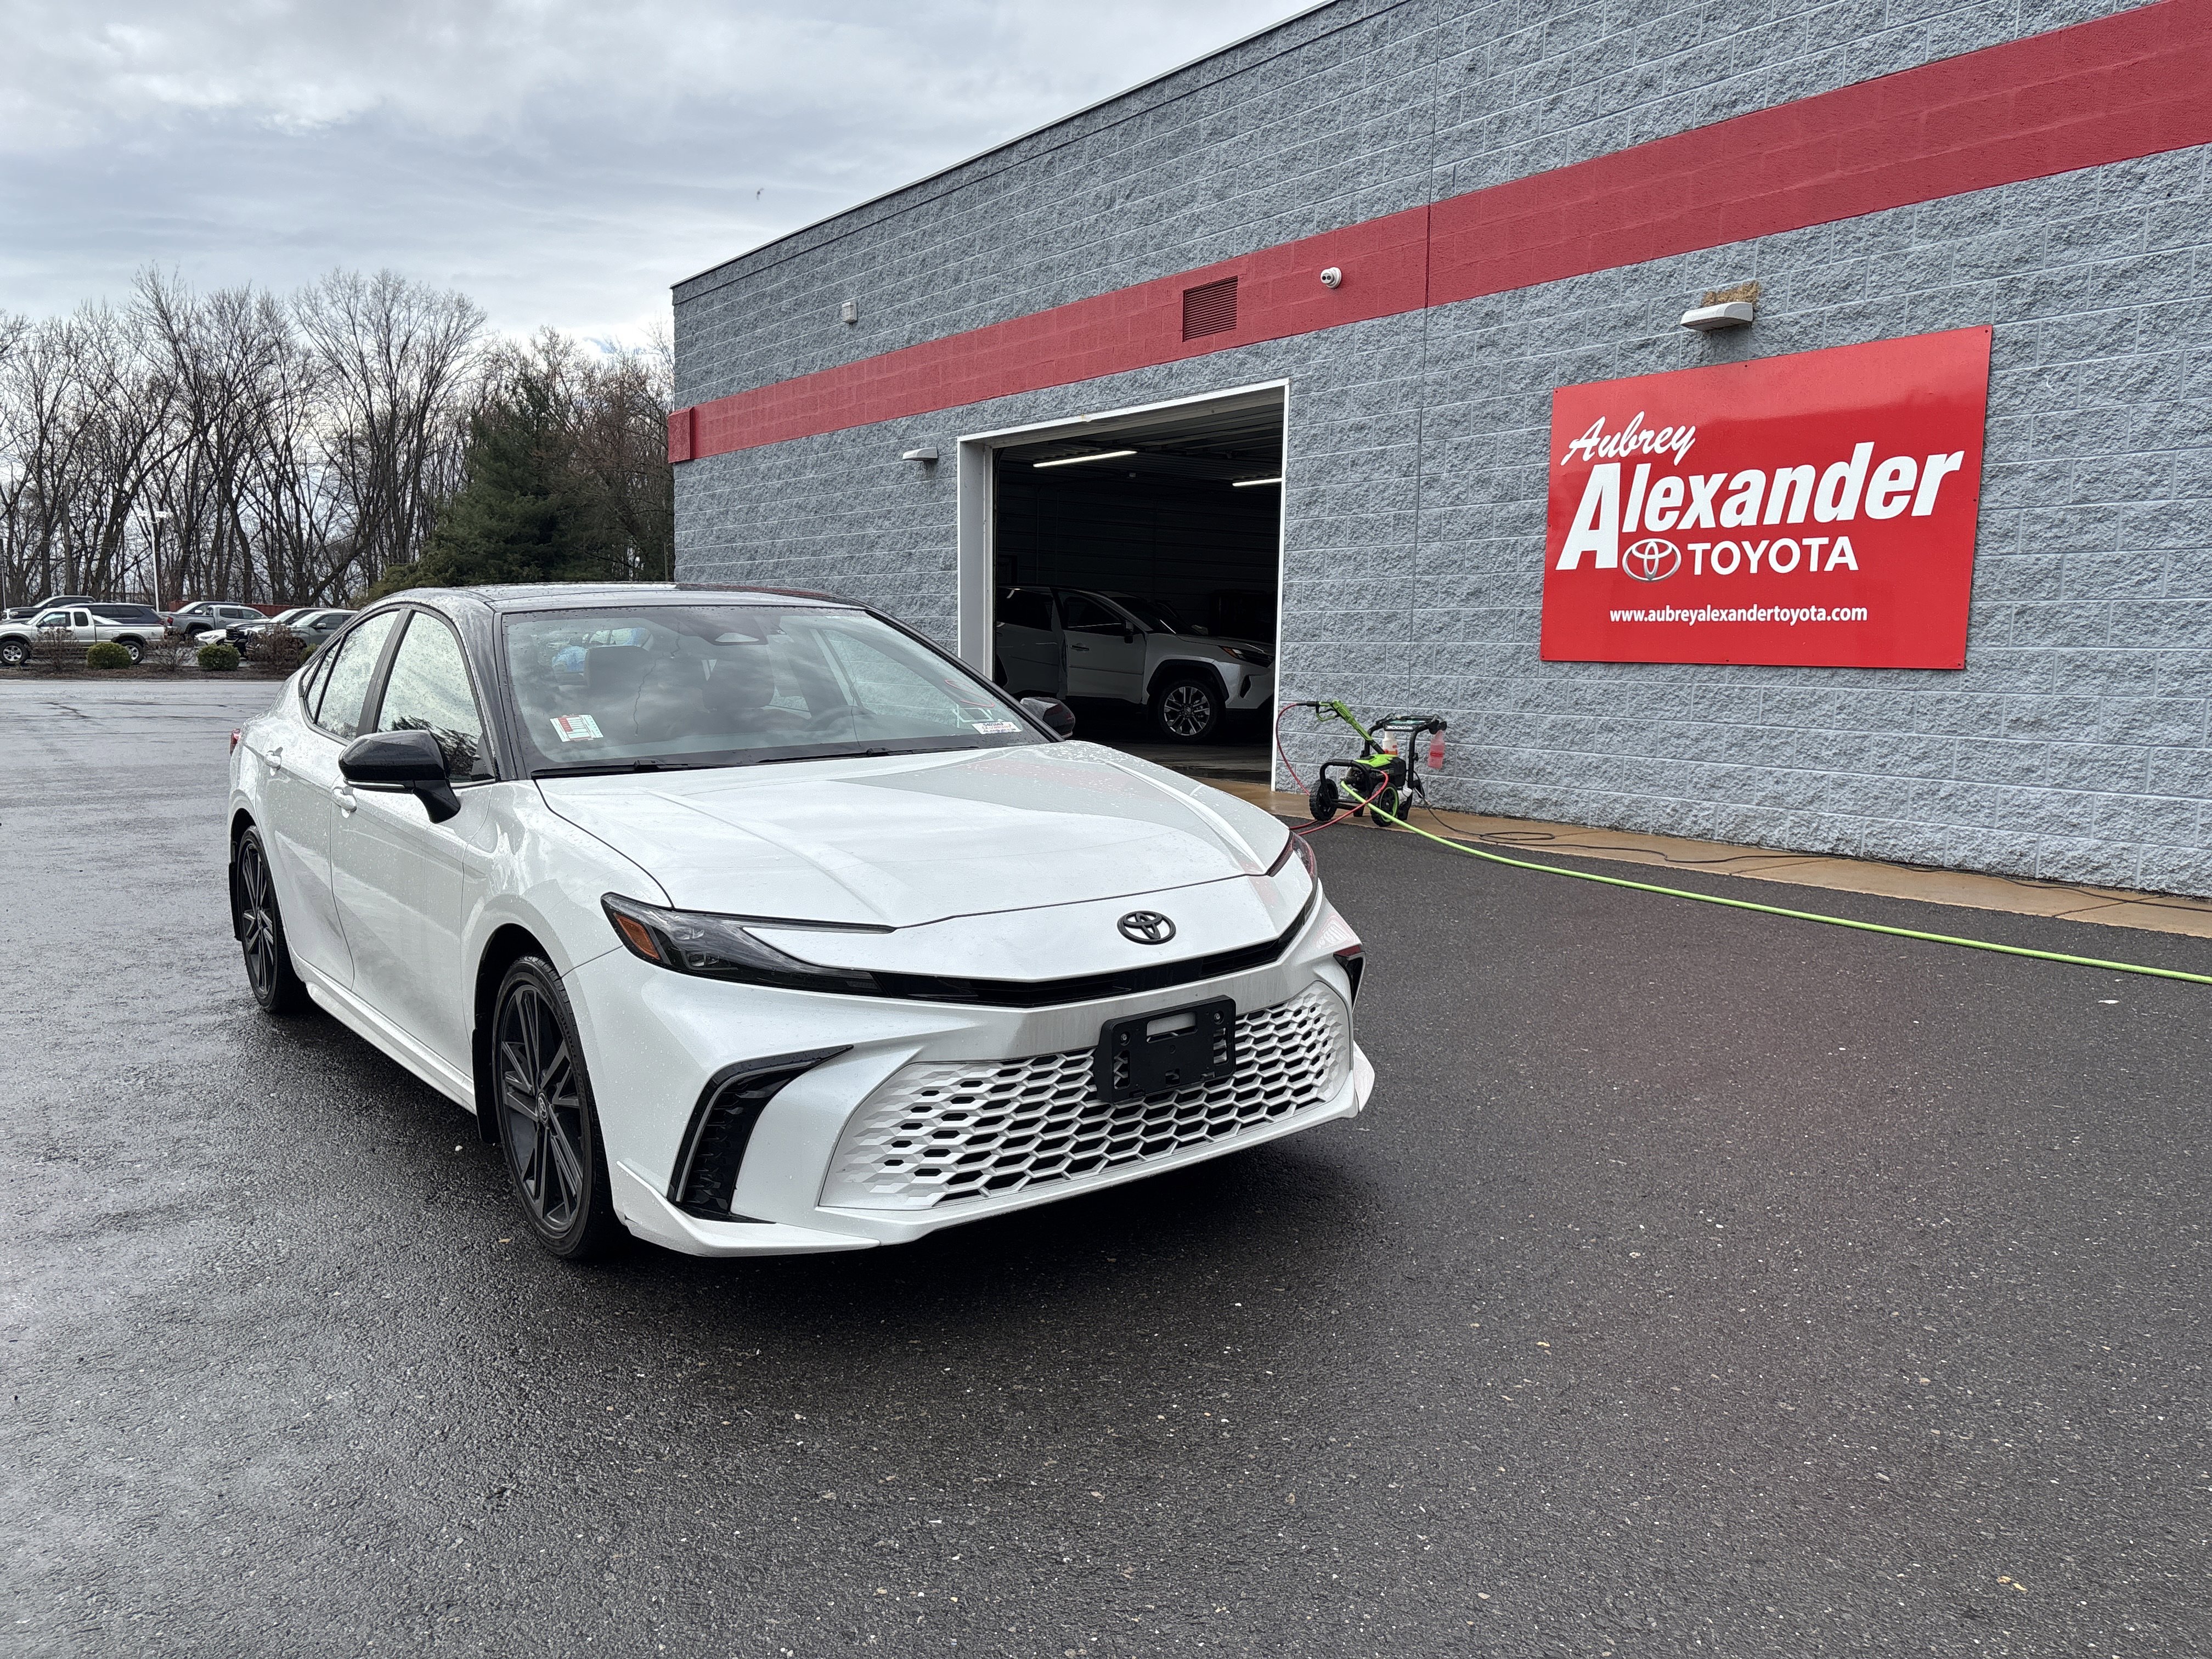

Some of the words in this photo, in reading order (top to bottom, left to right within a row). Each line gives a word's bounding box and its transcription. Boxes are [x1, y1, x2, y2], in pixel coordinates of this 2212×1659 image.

[1560, 411, 1696, 466] Aubrey
[1555, 441, 1965, 571] Alexander
[1687, 536, 1859, 575] TOYOTA
[1610, 603, 1868, 627] www.aubreyalexandertoyota.com
